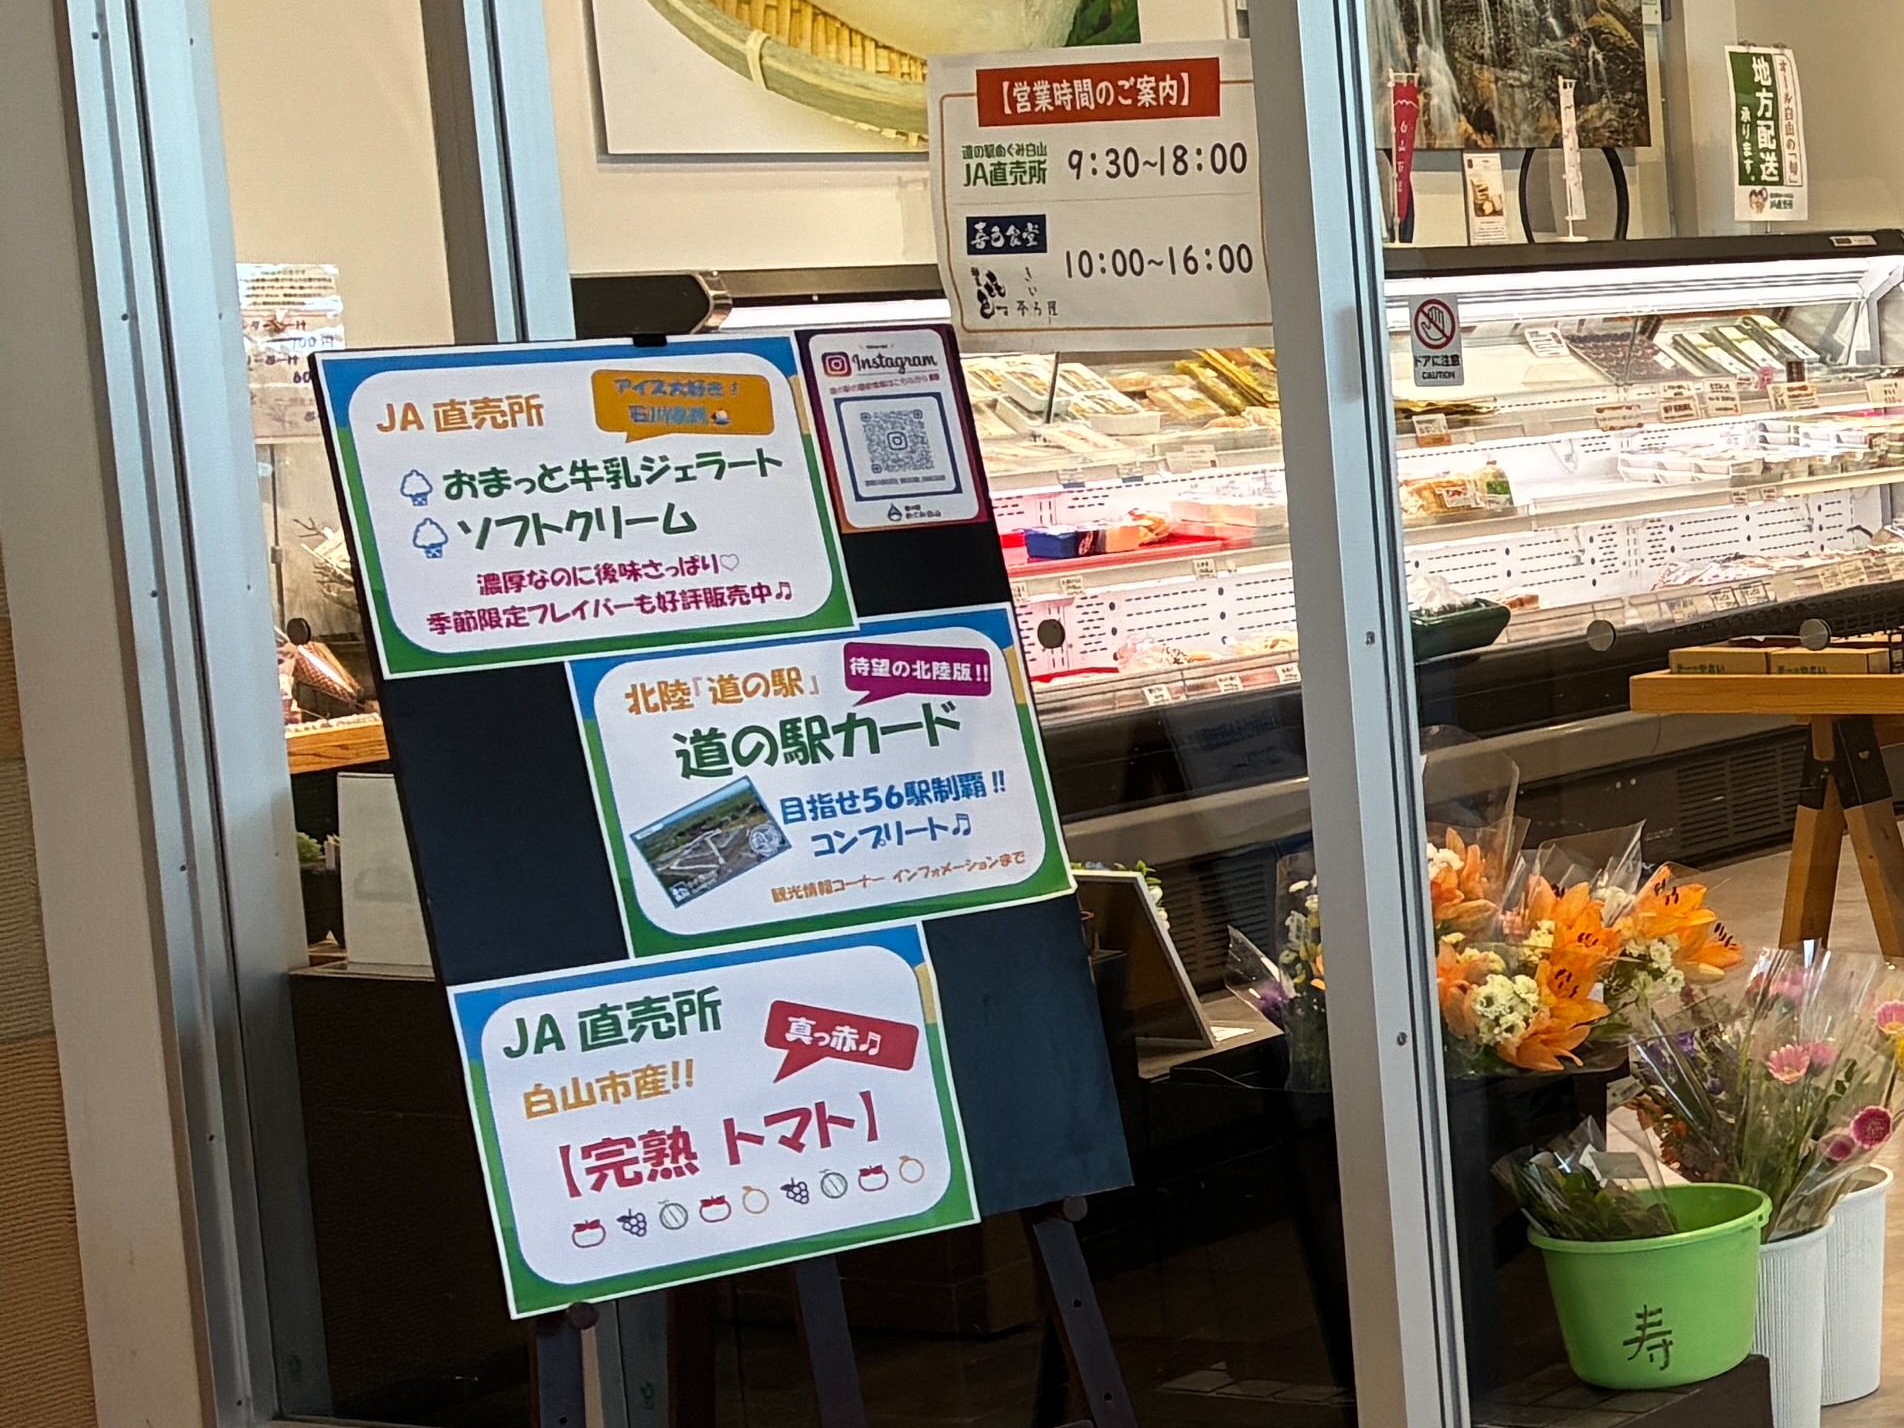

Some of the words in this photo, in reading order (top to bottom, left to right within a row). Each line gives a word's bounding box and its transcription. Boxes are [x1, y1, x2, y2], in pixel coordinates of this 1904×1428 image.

[1003, 73, 1189, 114] 【営業時間のご案内】
[1752, 56, 1779, 181] 地方配送
[1741, 106, 1755, 181] 承ります。
[963, 160, 1047, 187] JA直売所
[852, 352, 938, 374] Instagram
[1414, 354, 1460, 367] ドアに注意
[1422, 371, 1455, 379] CAUTION
[376, 402, 425, 432] JA
[434, 394, 545, 432] 直売所
[444, 448, 783, 502] おまっと牛乳ジェラート
[458, 503, 696, 551] ソフトクリーム
[672, 700, 962, 780] 道の駅カード
[770, 873, 885, 904] 観光情報コーナー
[502, 1012, 566, 1059] JA
[578, 986, 722, 1052] 直売所
[524, 1059, 695, 1120] 白山市産!!
[1623, 1304, 1675, 1371] 寿
